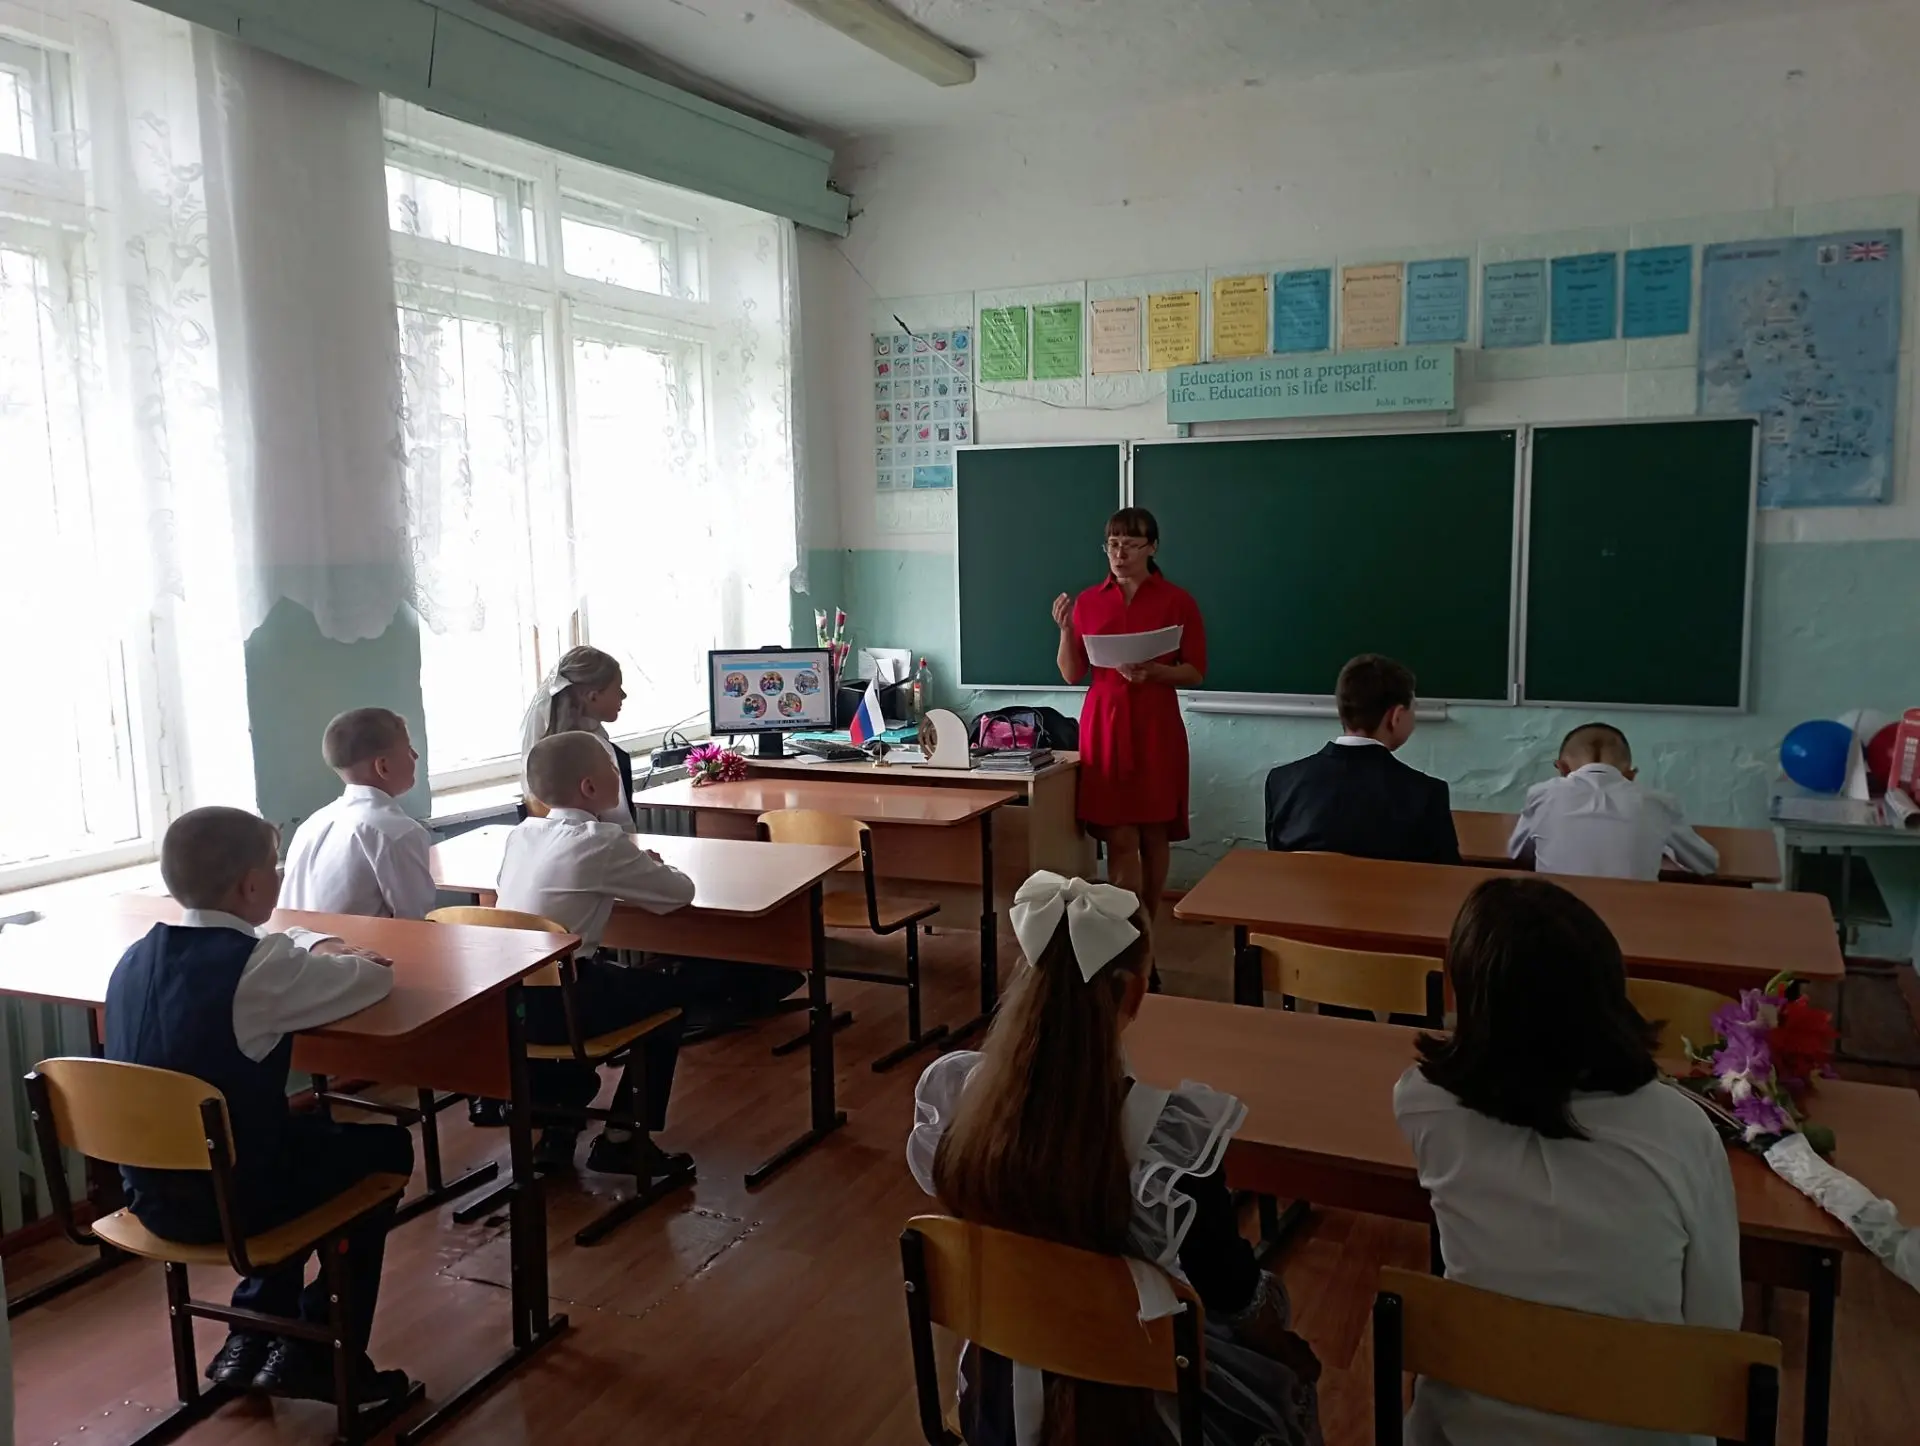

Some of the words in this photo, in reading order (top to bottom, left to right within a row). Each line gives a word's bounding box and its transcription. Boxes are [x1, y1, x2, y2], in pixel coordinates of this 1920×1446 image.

[1180, 370, 1253, 387] Education
[1260, 368, 1272, 381] is
[1276, 366, 1299, 380] not
[1304, 367, 1313, 378] a
[1318, 359, 1408, 380] preparation
[1415, 355, 1439, 371] for
[1209, 385, 1281, 401] Education
[1287, 382, 1299, 396] is
[1303, 378, 1328, 395] life
[1334, 375, 1377, 393] itself.
[1376, 397, 1397, 408] John
[1403, 396, 1435, 406] Dewey
